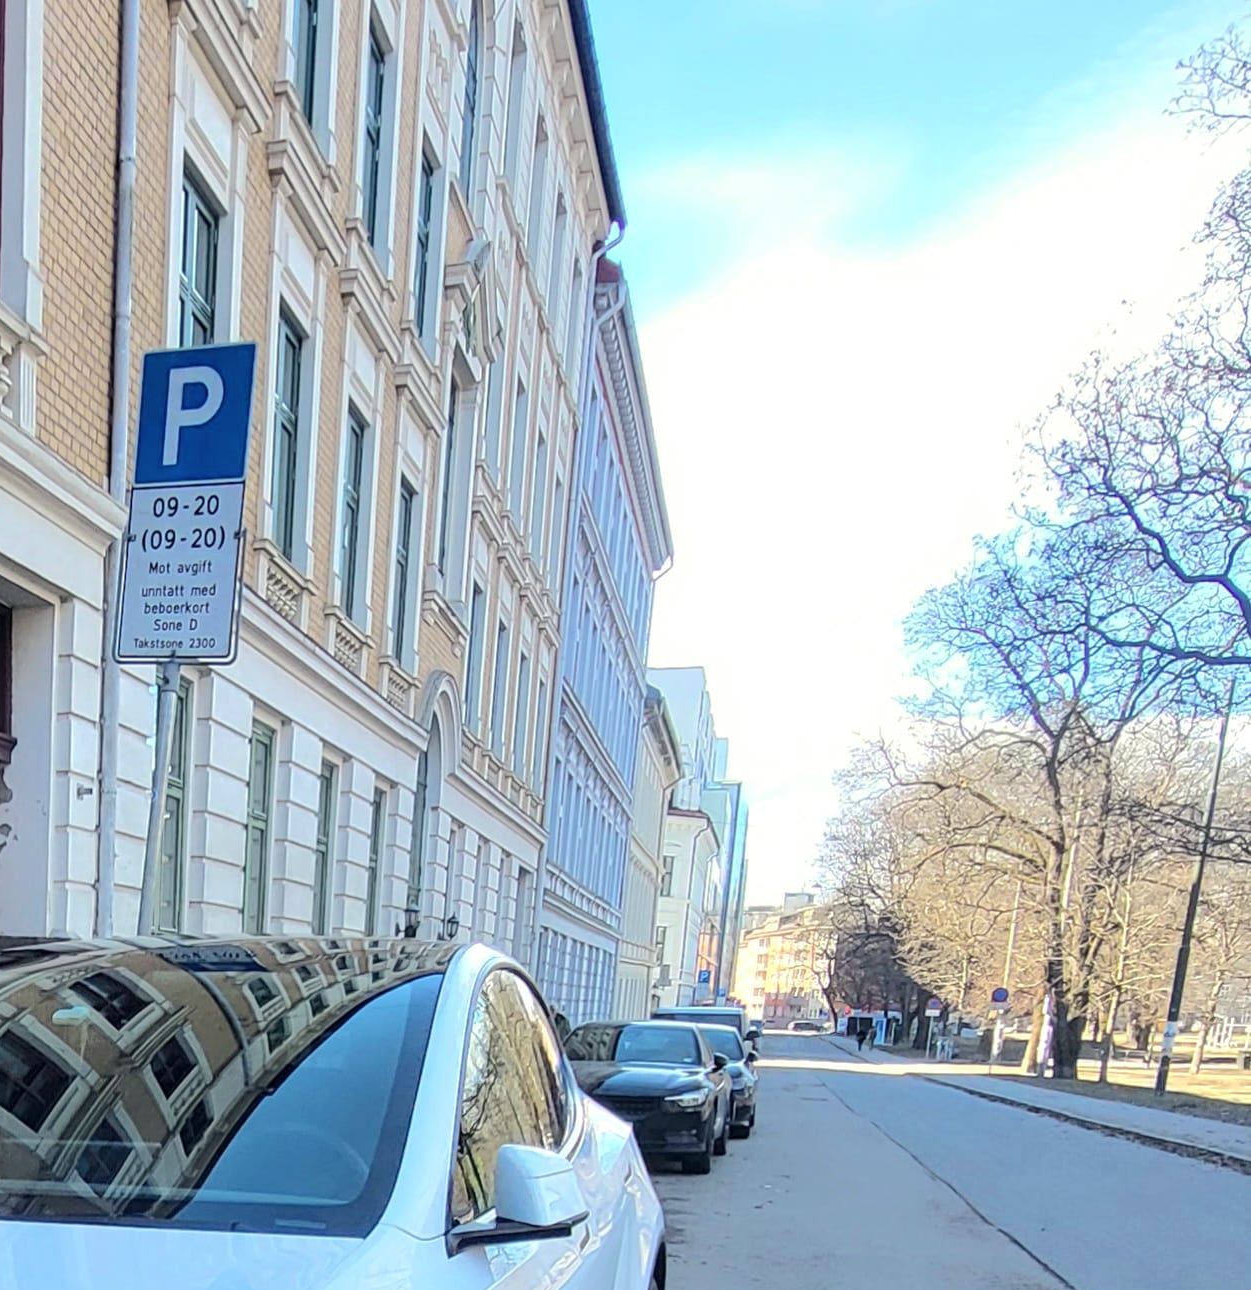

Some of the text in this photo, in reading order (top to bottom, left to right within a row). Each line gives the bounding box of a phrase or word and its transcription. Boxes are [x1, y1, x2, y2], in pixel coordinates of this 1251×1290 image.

[162, 365, 224, 466] P
[153, 494, 219, 517] 09-20
[142, 525, 225, 552] (09-20)
[149, 559, 212, 575] Mot avgift
[142, 584, 216, 597] unntatt med
[144, 602, 210, 614] beboerkort
[153, 618, 198, 631] Sone D
[134, 638, 216, 649] Takstsone 2300
